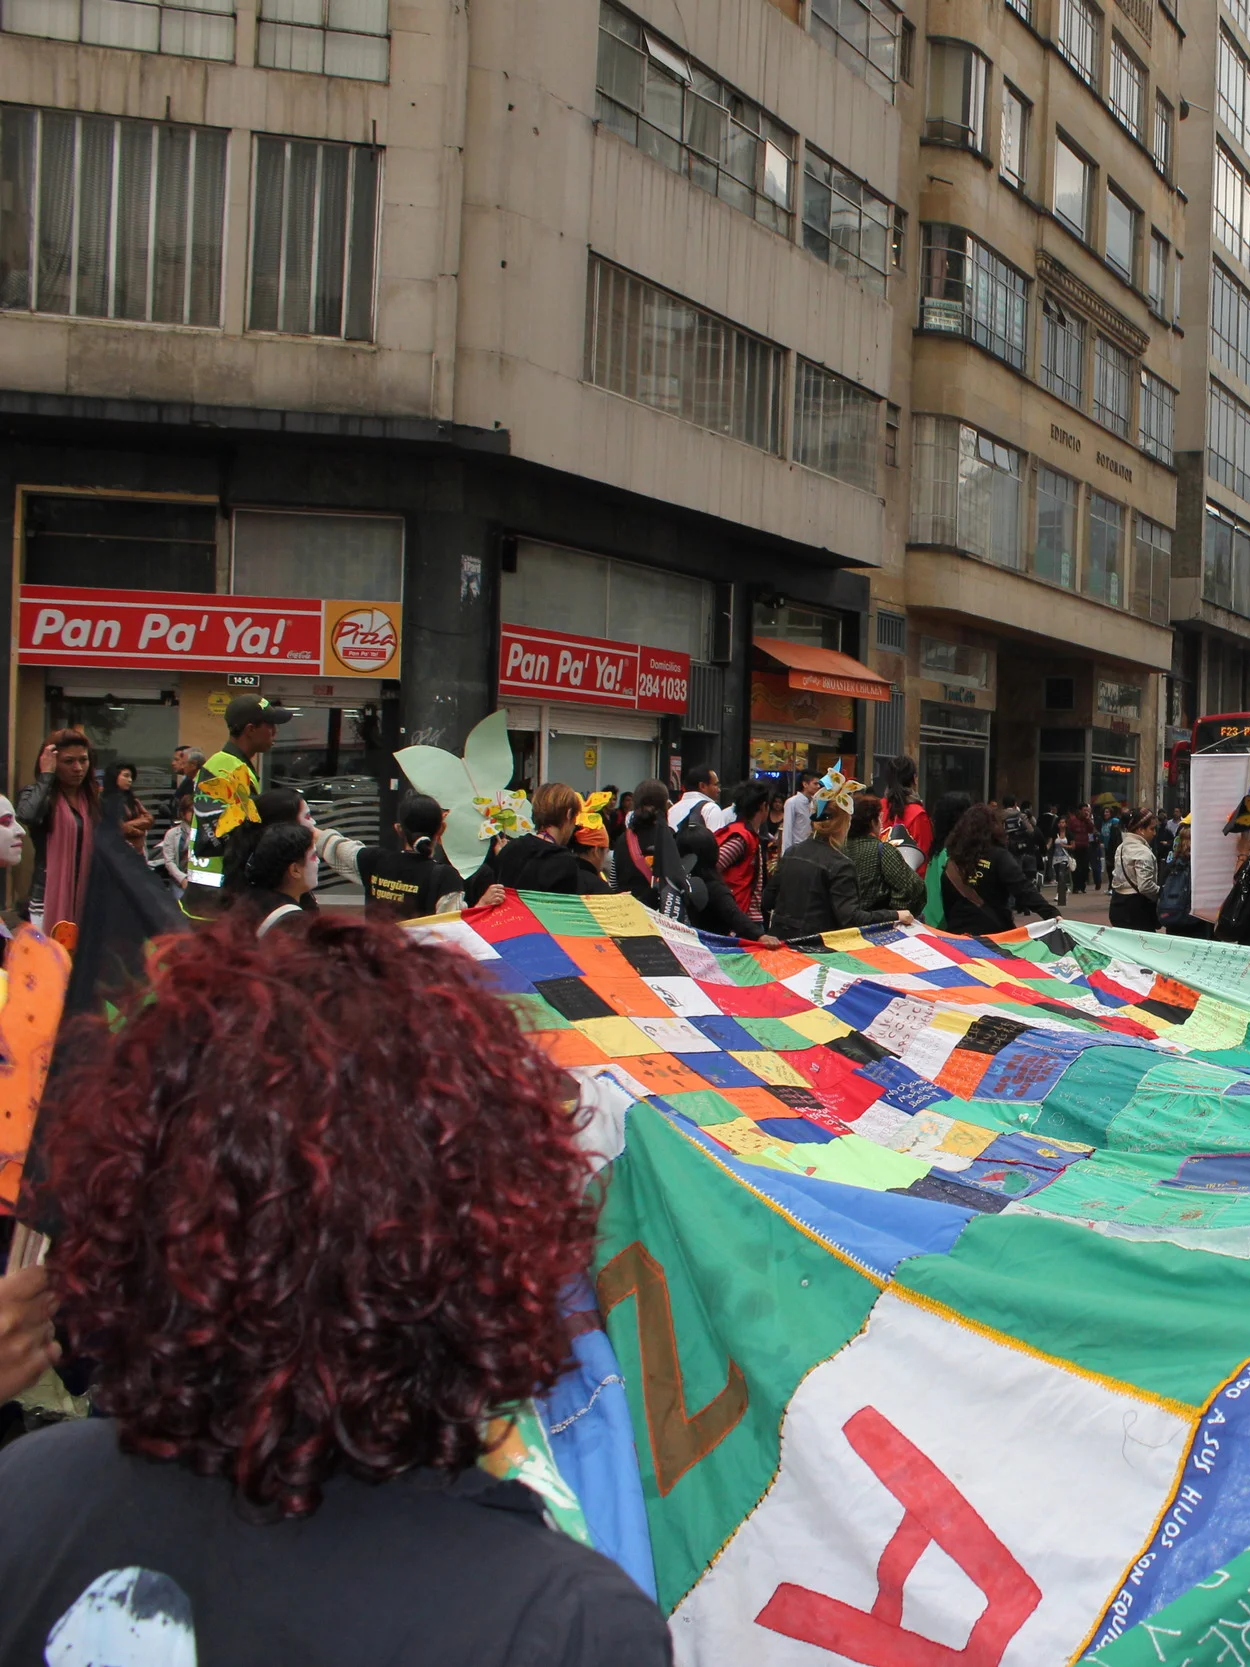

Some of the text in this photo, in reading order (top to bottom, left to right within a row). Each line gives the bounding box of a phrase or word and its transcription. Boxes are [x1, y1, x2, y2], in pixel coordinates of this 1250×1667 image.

[1050, 423, 1081, 453] EDIFICIO
[32, 608, 286, 656] Pan Pa' Ya!
[334, 621, 397, 647] Pizza
[506, 643, 624, 691] Pan Pa' Ya!
[650, 659, 682, 673] Domicilios
[233, 676, 255, 685] 14-62
[639, 673, 687, 701] 2841033
[822, 677, 856, 692] BROASTER
[855, 682, 882, 695] CHICKEN
[1220, 726, 1239, 737] F23
[378, 877, 419, 893] vergüenza
[1207, 1407, 1226, 1426] A
[1192, 1431, 1220, 1474] SUS
[1161, 1485, 1203, 1548] HIJOS
[1130, 1552, 1156, 1585] CON
